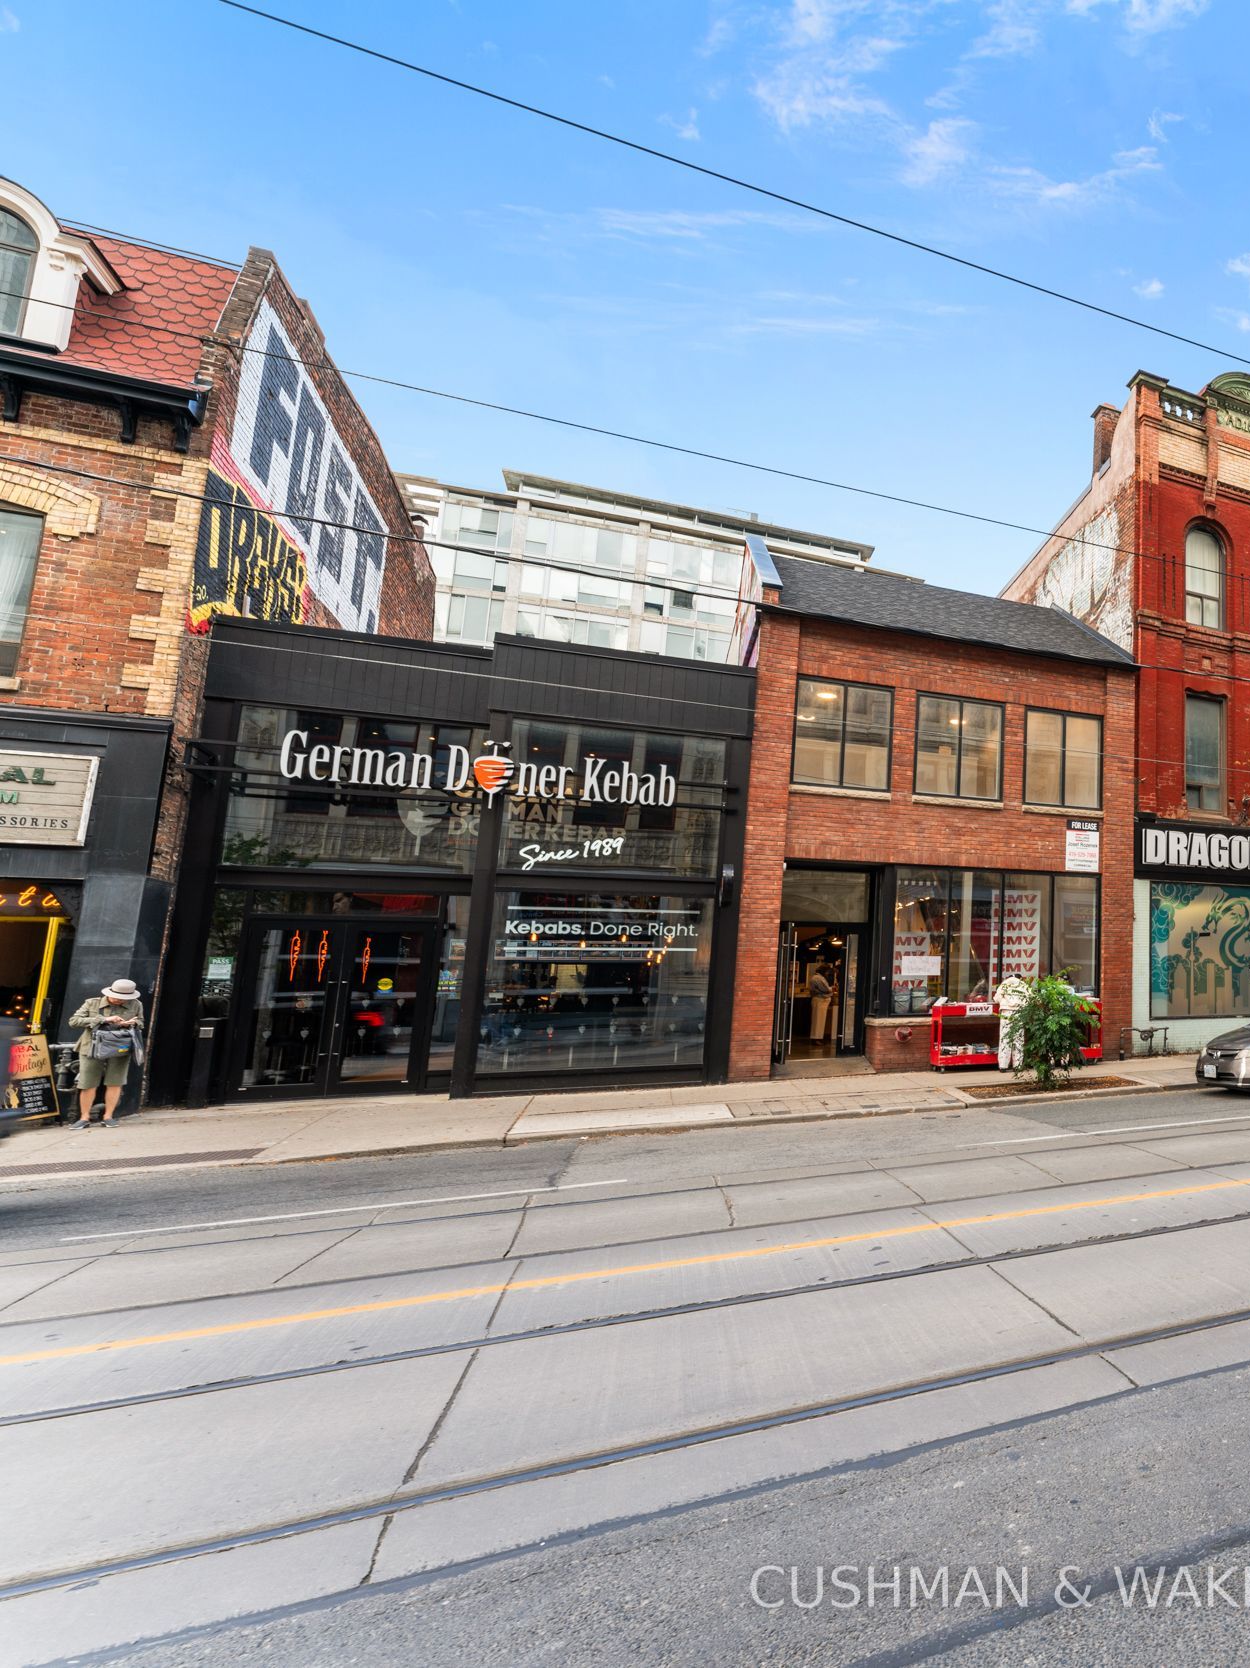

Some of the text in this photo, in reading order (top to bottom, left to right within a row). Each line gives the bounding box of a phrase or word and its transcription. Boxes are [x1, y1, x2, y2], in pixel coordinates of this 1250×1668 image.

[280, 729, 431, 790] German
[583, 757, 676, 808] Kebab
[1071, 821, 1098, 831] FOR LEASE
[519, 837, 625, 871] Since 1989
[505, 920, 699, 940] Kebabs. Done Right.
[968, 1005, 990, 1013] BMV
